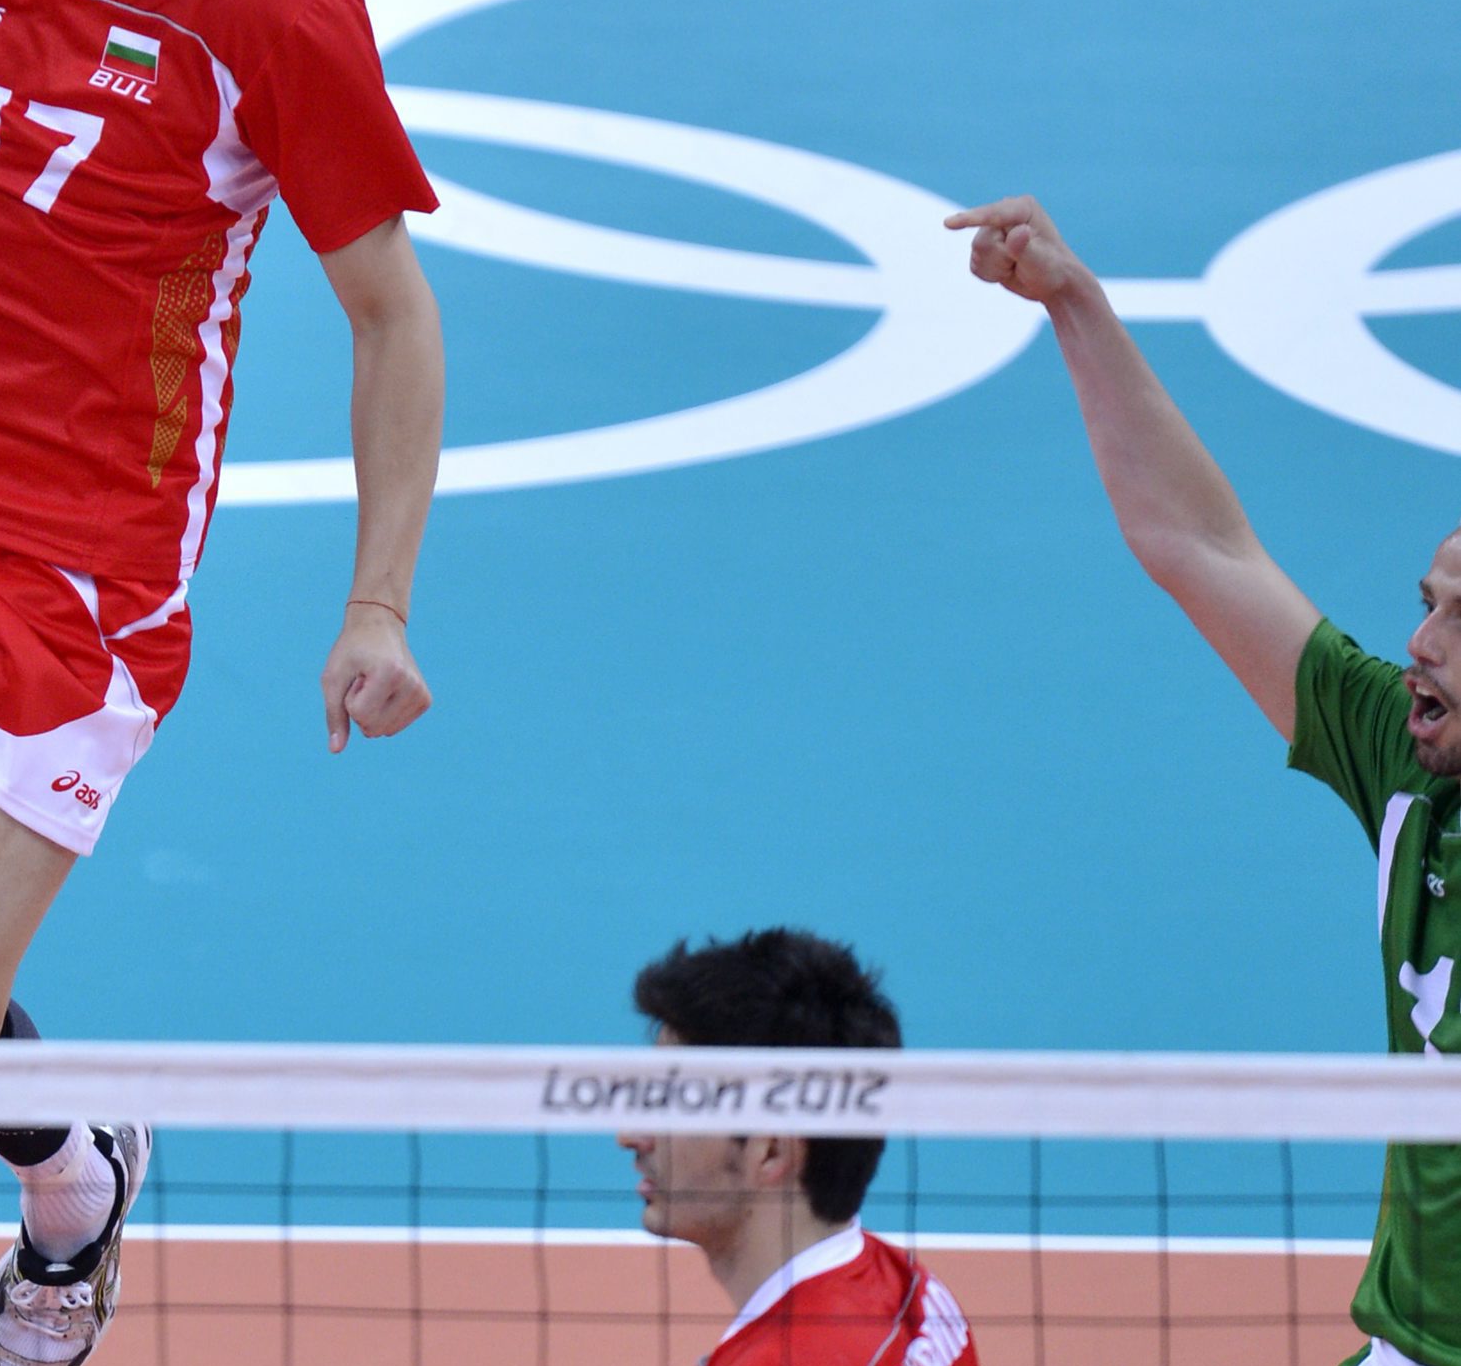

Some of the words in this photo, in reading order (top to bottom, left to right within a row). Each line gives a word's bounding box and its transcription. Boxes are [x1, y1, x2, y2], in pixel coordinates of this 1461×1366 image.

[88, 69, 152, 104] BUL
[540, 1065, 746, 1113] London
[762, 1066, 889, 1115] 2012
